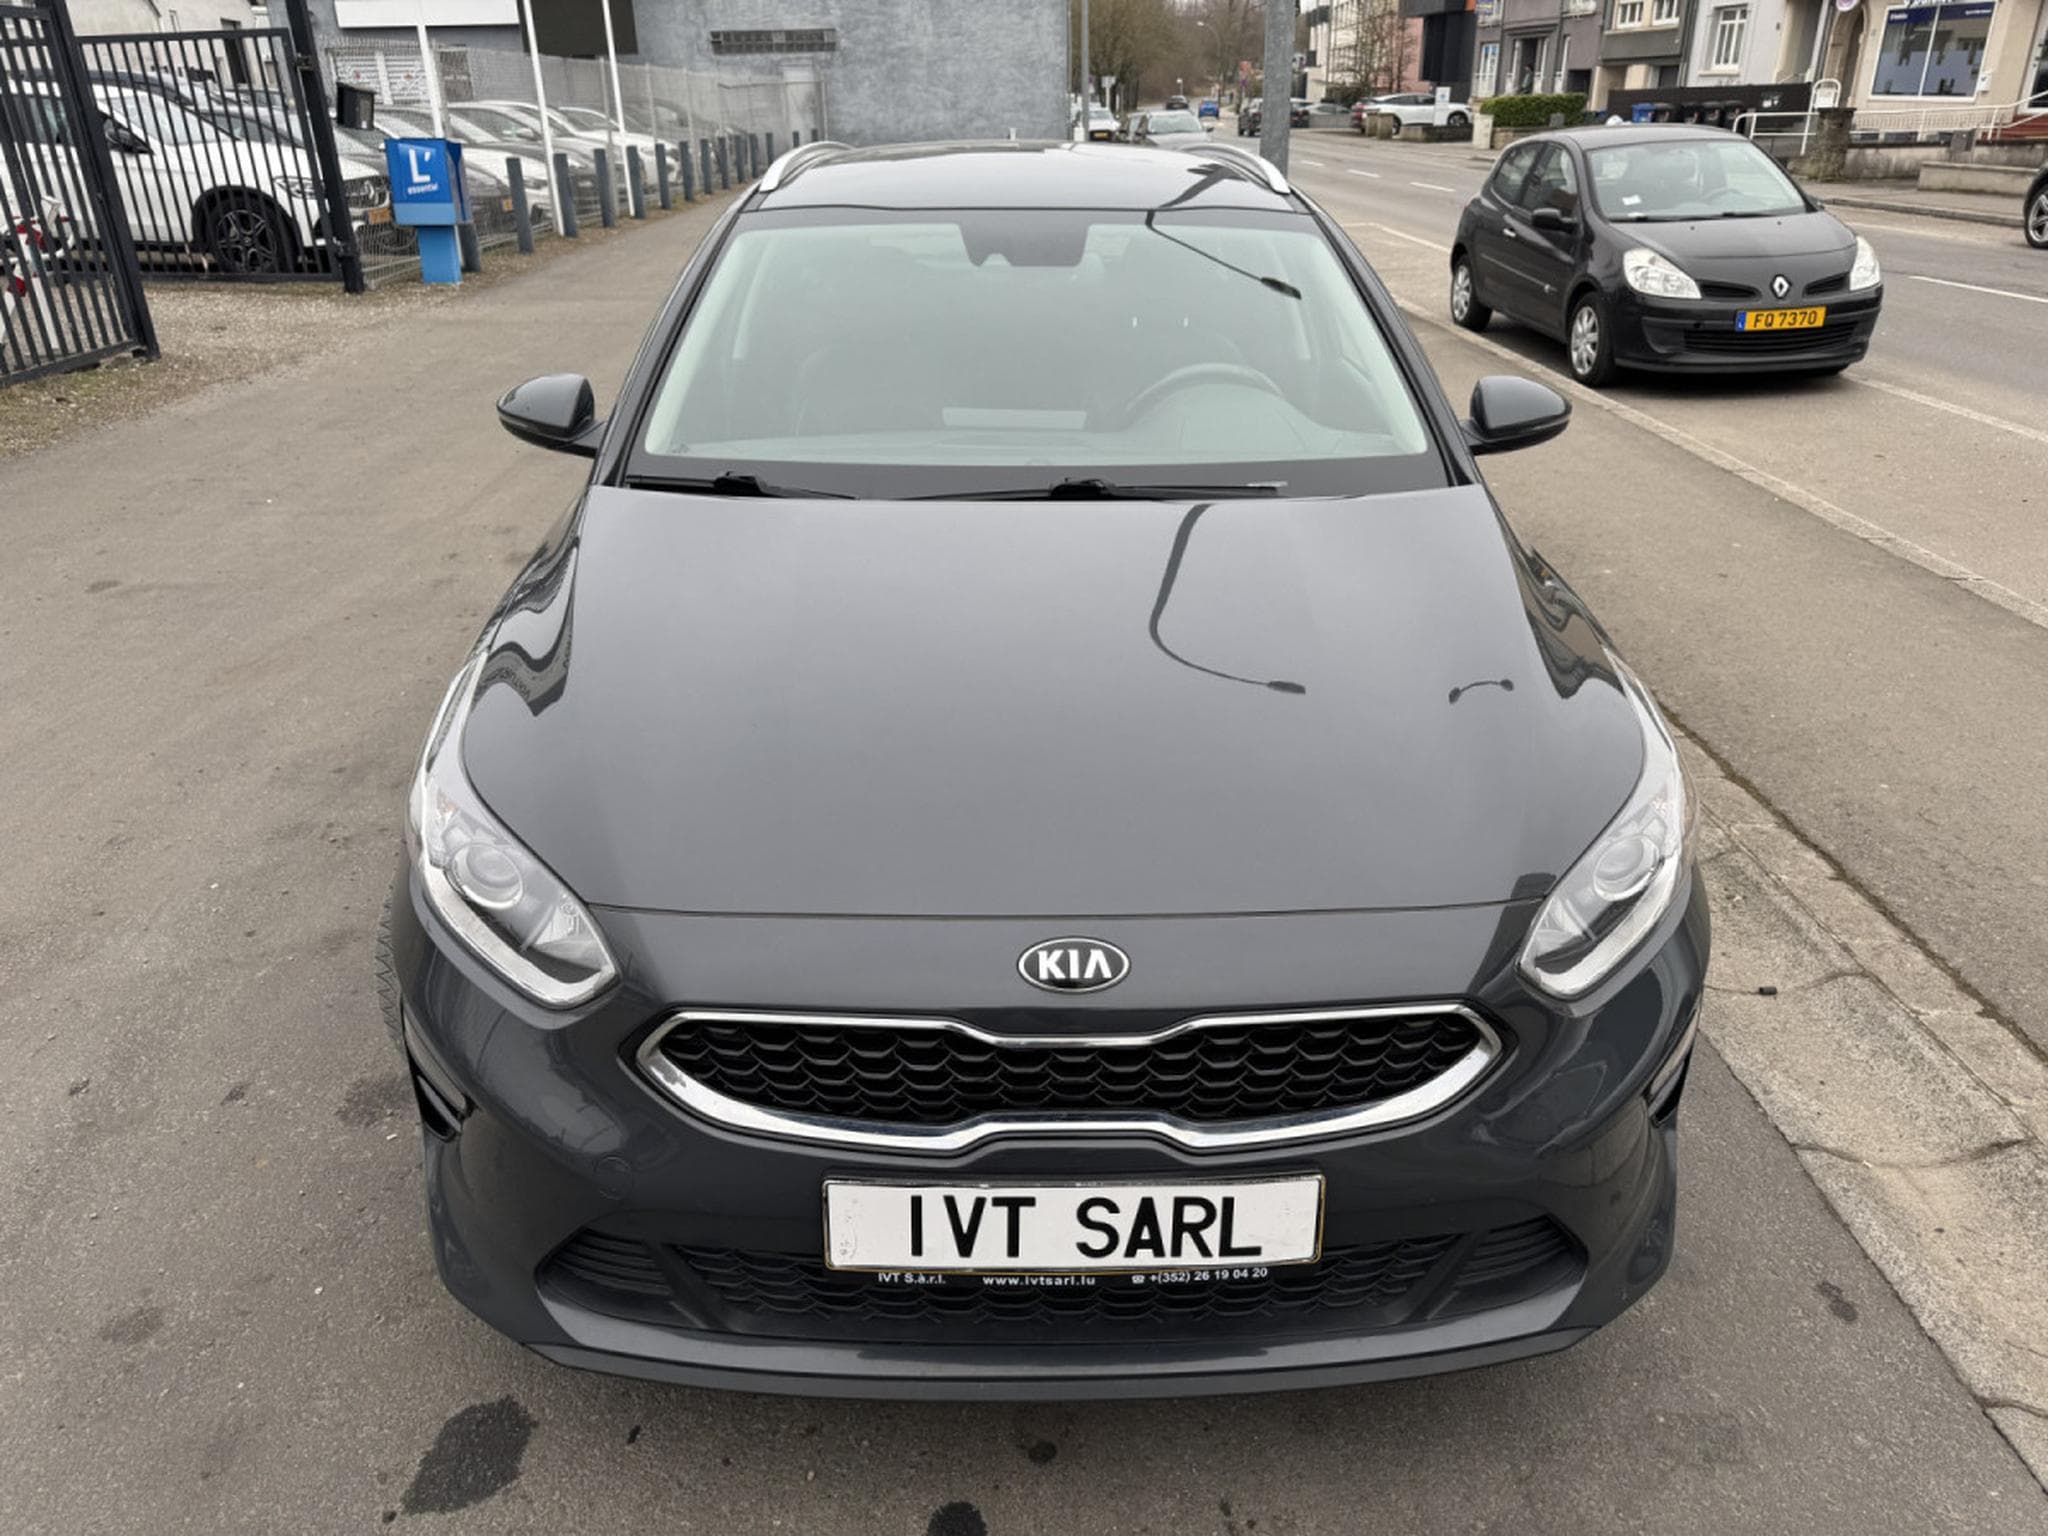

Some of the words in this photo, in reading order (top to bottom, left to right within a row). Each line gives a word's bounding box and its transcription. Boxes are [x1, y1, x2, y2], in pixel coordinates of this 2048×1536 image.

[1753, 313, 1775, 329] FQ
[1778, 310, 1818, 327] 7370
[1037, 948, 1113, 980] KIA
[1075, 1196, 1263, 1259] SARL
[878, 1272, 900, 1283] IVT
[982, 1275, 1096, 1286] www.ivtsarl.lu
[1149, 1270, 1191, 1284] +(352)
[1193, 1270, 1210, 1281] 26
[1214, 1269, 1230, 1280] 19
[1232, 1268, 1249, 1280] 04
[1251, 1267, 1268, 1279] 20
